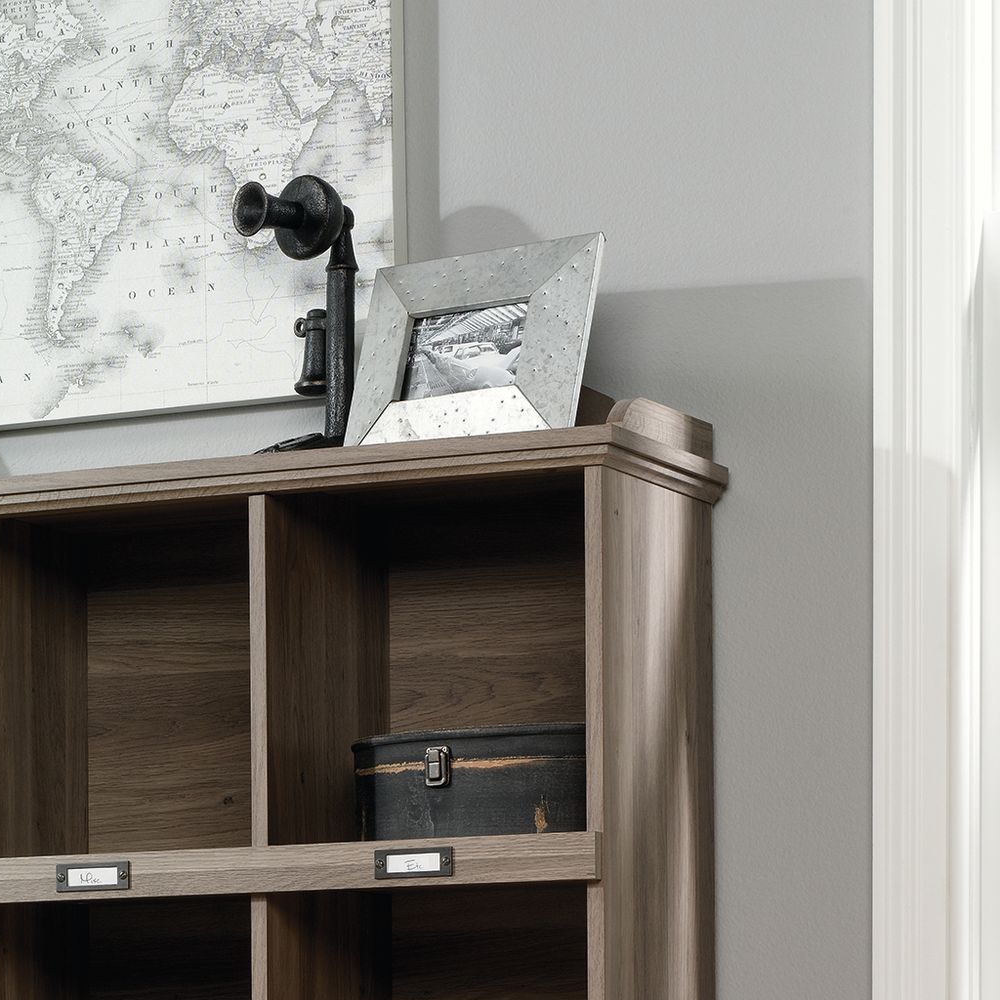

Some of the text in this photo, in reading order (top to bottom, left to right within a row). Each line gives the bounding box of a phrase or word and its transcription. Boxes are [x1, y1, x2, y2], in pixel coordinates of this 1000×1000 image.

[95, 39, 174, 57] NORTH
[51, 75, 170, 97] ATLANTIC
[66, 111, 152, 130] OCEAN
[137, 184, 218, 202] SOUTH
[115, 231, 231, 253] ATLANTIC
[128, 282, 216, 300] OCEAN
